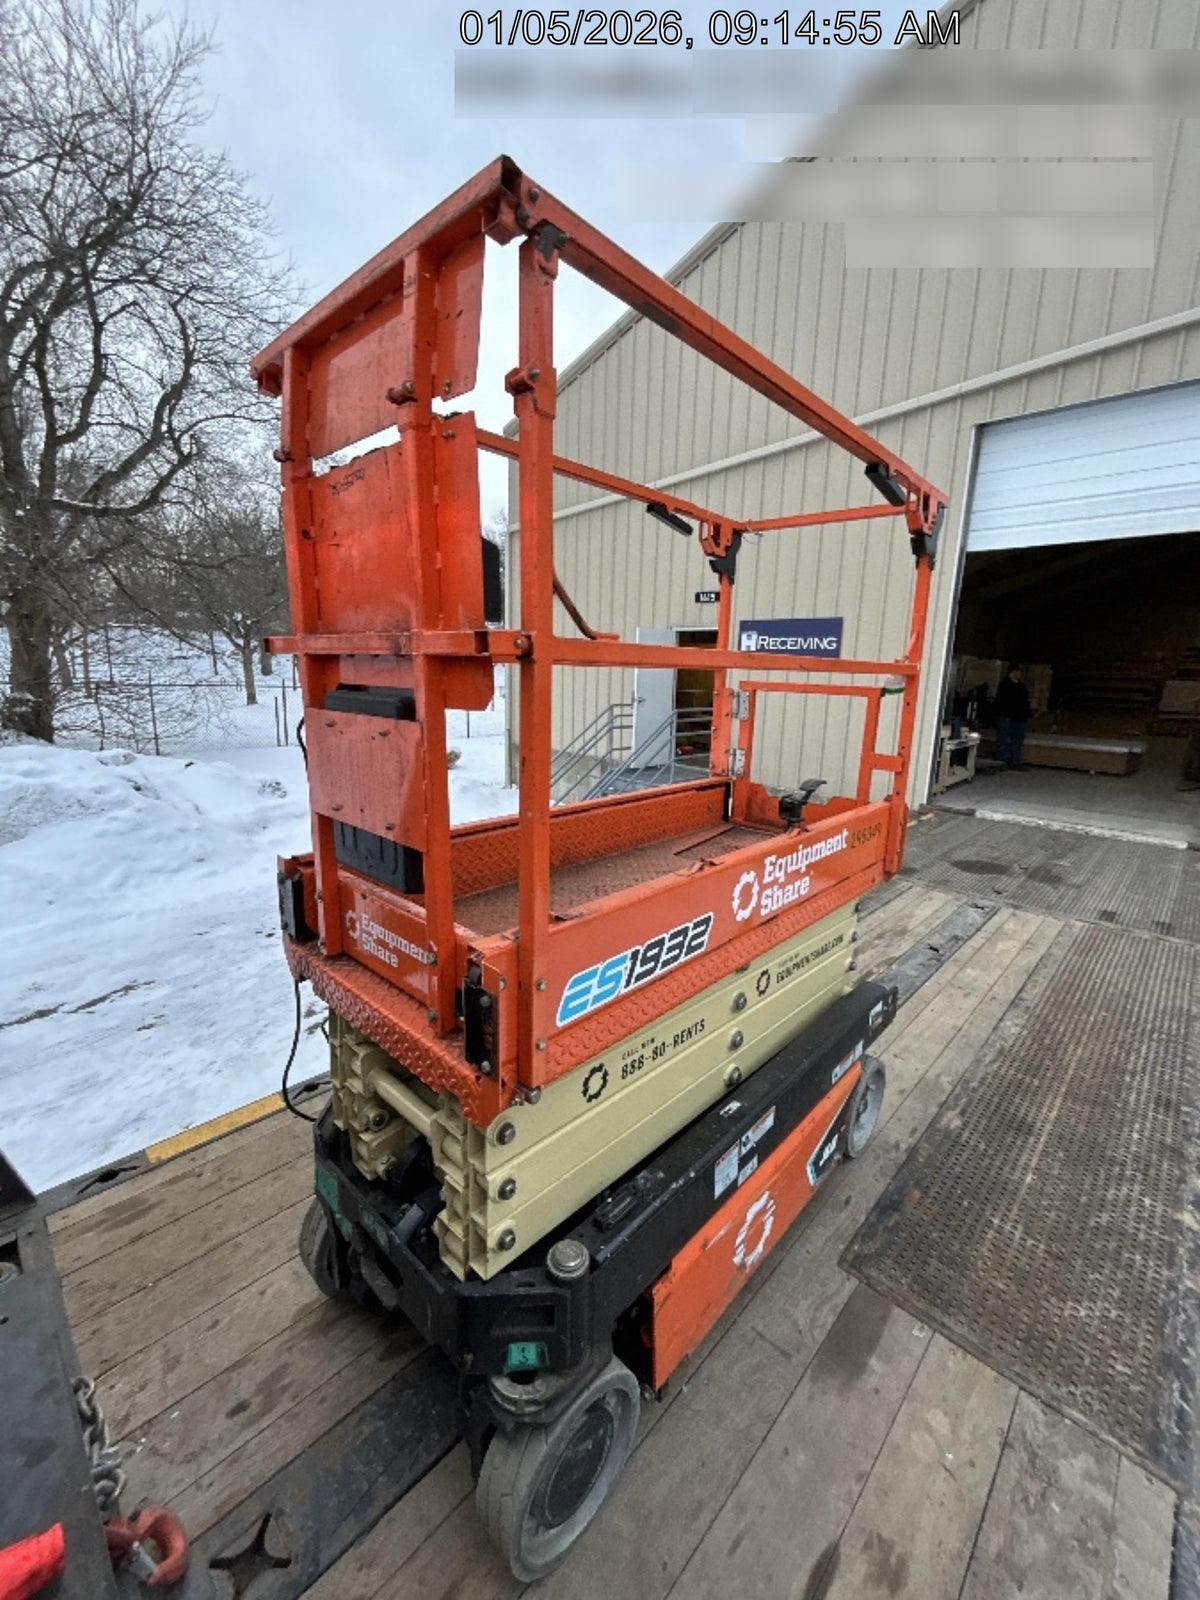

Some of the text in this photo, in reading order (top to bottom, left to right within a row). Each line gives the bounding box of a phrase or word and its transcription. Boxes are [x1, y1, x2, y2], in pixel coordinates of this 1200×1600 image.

[757, 635, 838, 650] RECEIVING
[762, 828, 849, 884] Equipment
[760, 876, 810, 916] Share
[361, 913, 432, 965] Equipmen
[361, 933, 399, 968] Share
[556, 912, 714, 1026] ES1932
[621, 1018, 705, 1080] 888-80-RENTS
